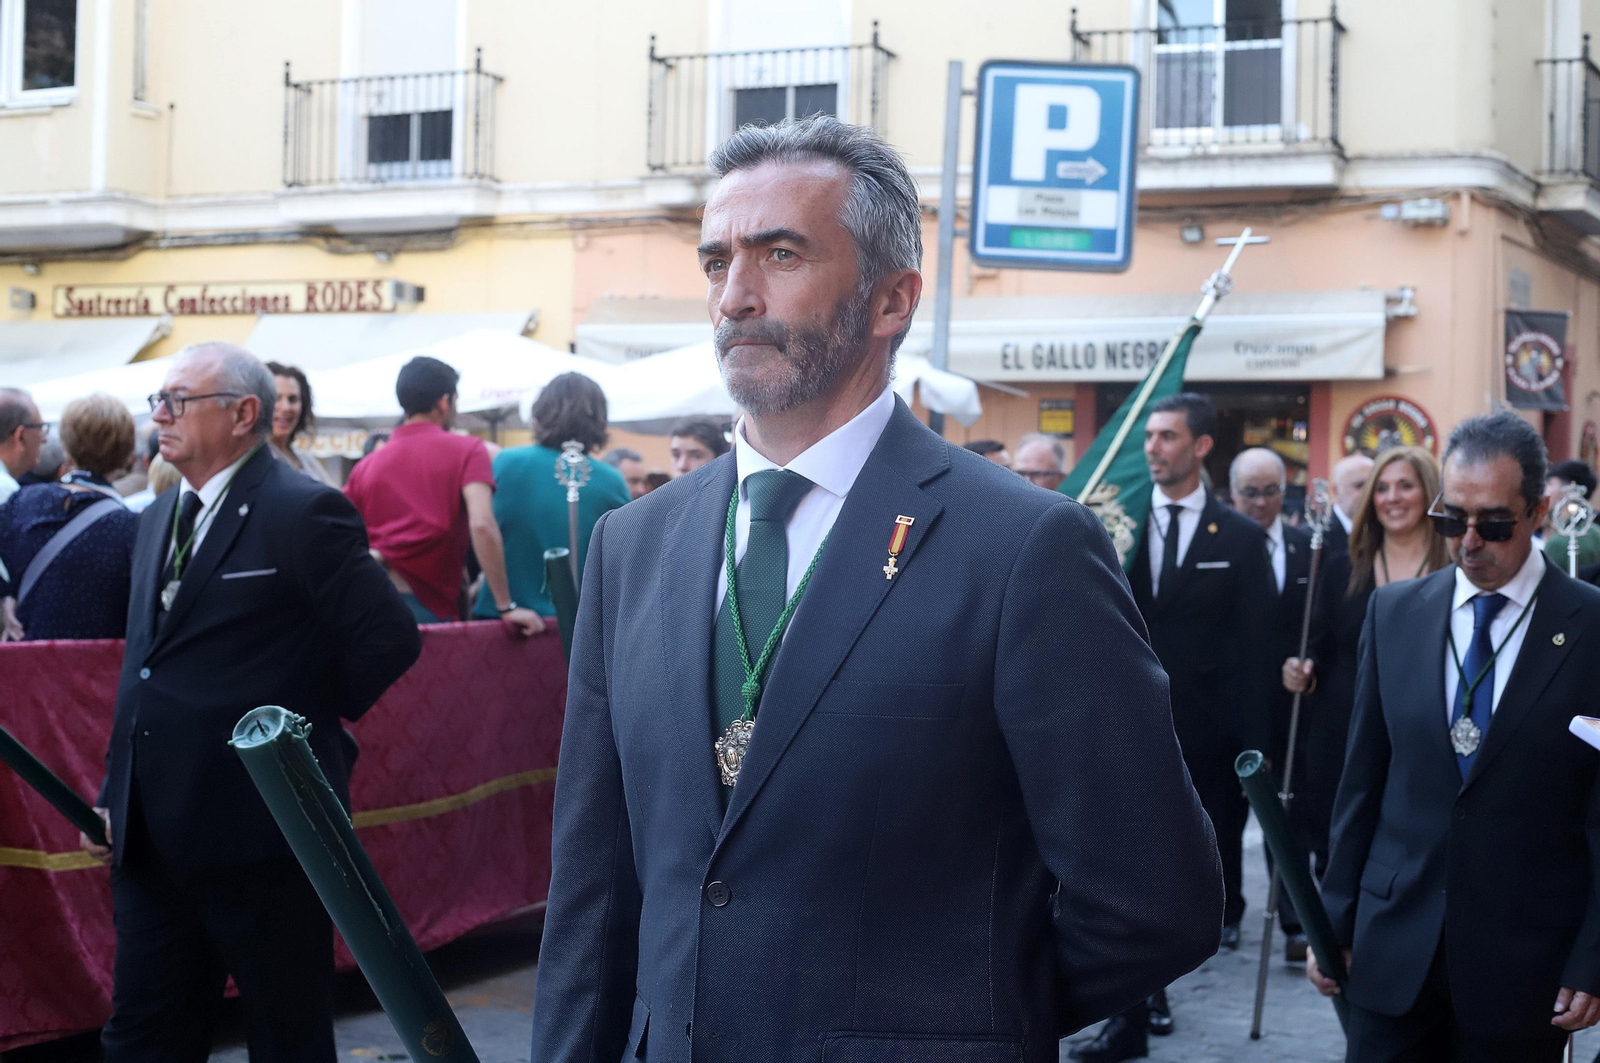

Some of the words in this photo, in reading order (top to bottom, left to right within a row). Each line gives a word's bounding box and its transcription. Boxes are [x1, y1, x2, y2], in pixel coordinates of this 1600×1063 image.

[1011, 83, 1101, 182] P
[164, 284, 290, 315] Confecciones
[305, 279, 382, 313] RODES
[1001, 343, 1024, 370] EL
[1032, 342, 1097, 370] GALLO
